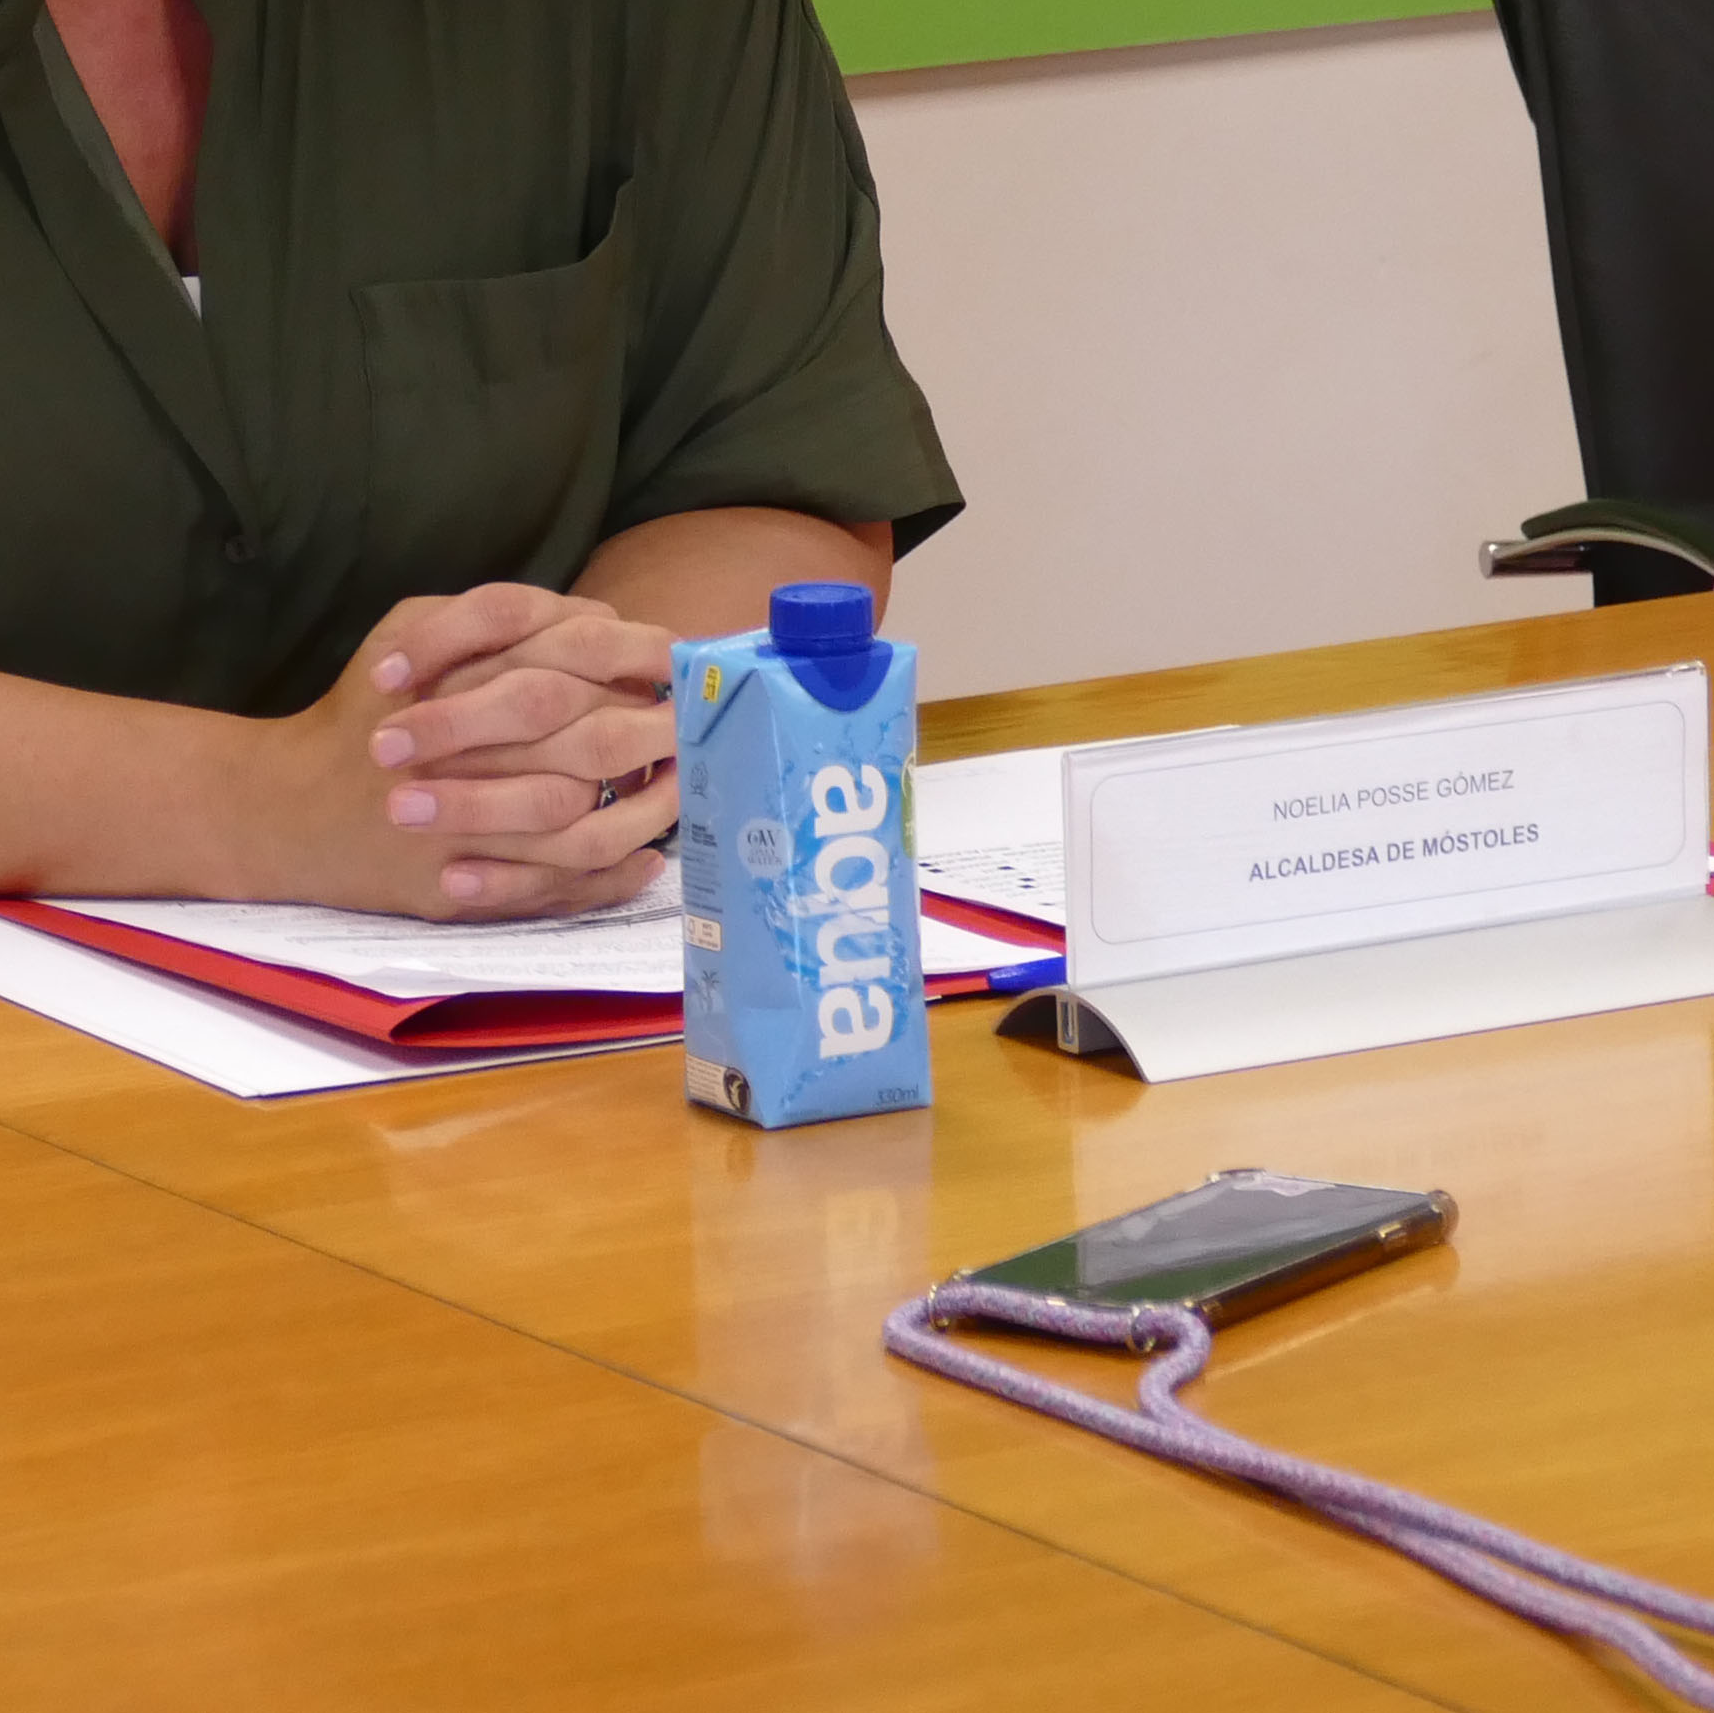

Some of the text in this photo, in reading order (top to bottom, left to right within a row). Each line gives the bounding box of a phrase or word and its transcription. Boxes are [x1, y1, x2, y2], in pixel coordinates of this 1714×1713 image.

[1273, 770, 1515, 821] NOELIA POSSE GÓMEZ
[1249, 823, 1539, 882] ALCALDESA DE MÓSTOLES
[811, 763, 894, 1060] aqua
